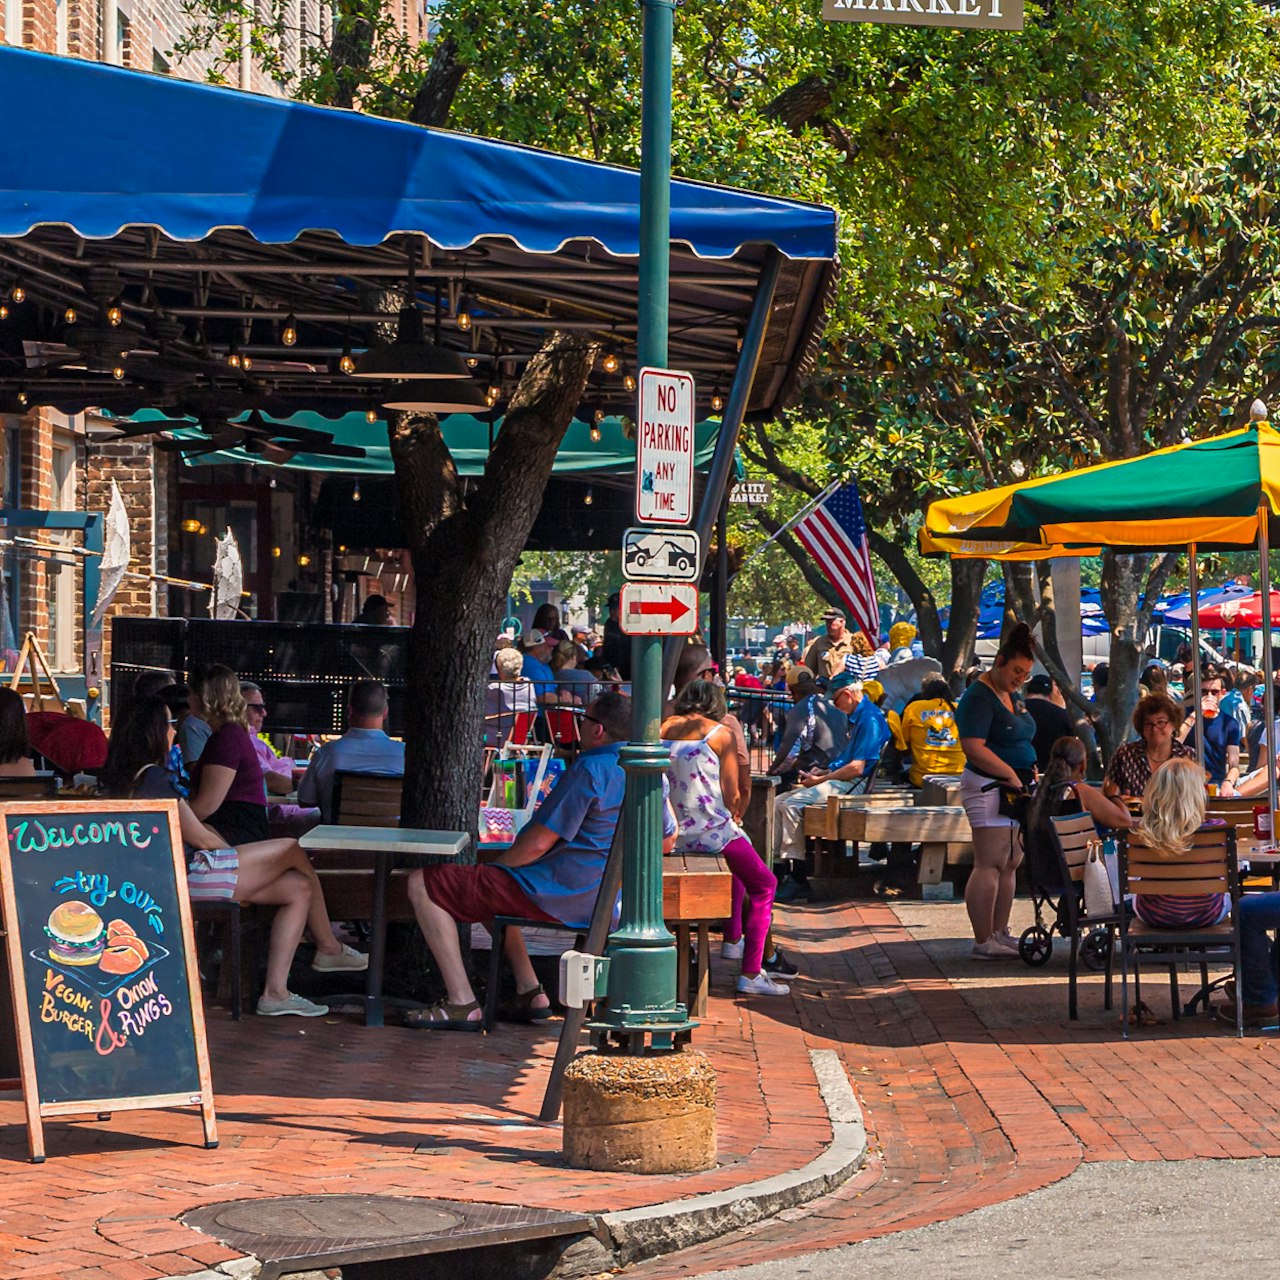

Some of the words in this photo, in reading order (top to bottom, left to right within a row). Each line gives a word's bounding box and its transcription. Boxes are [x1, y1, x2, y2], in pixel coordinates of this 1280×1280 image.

[657, 384, 676, 413] NO
[644, 421, 689, 453] PARKING
[655, 461, 676, 481] ANY
[741, 483, 766, 493] CITY
[654, 492, 675, 511] TIME
[76, 870, 117, 907] try
